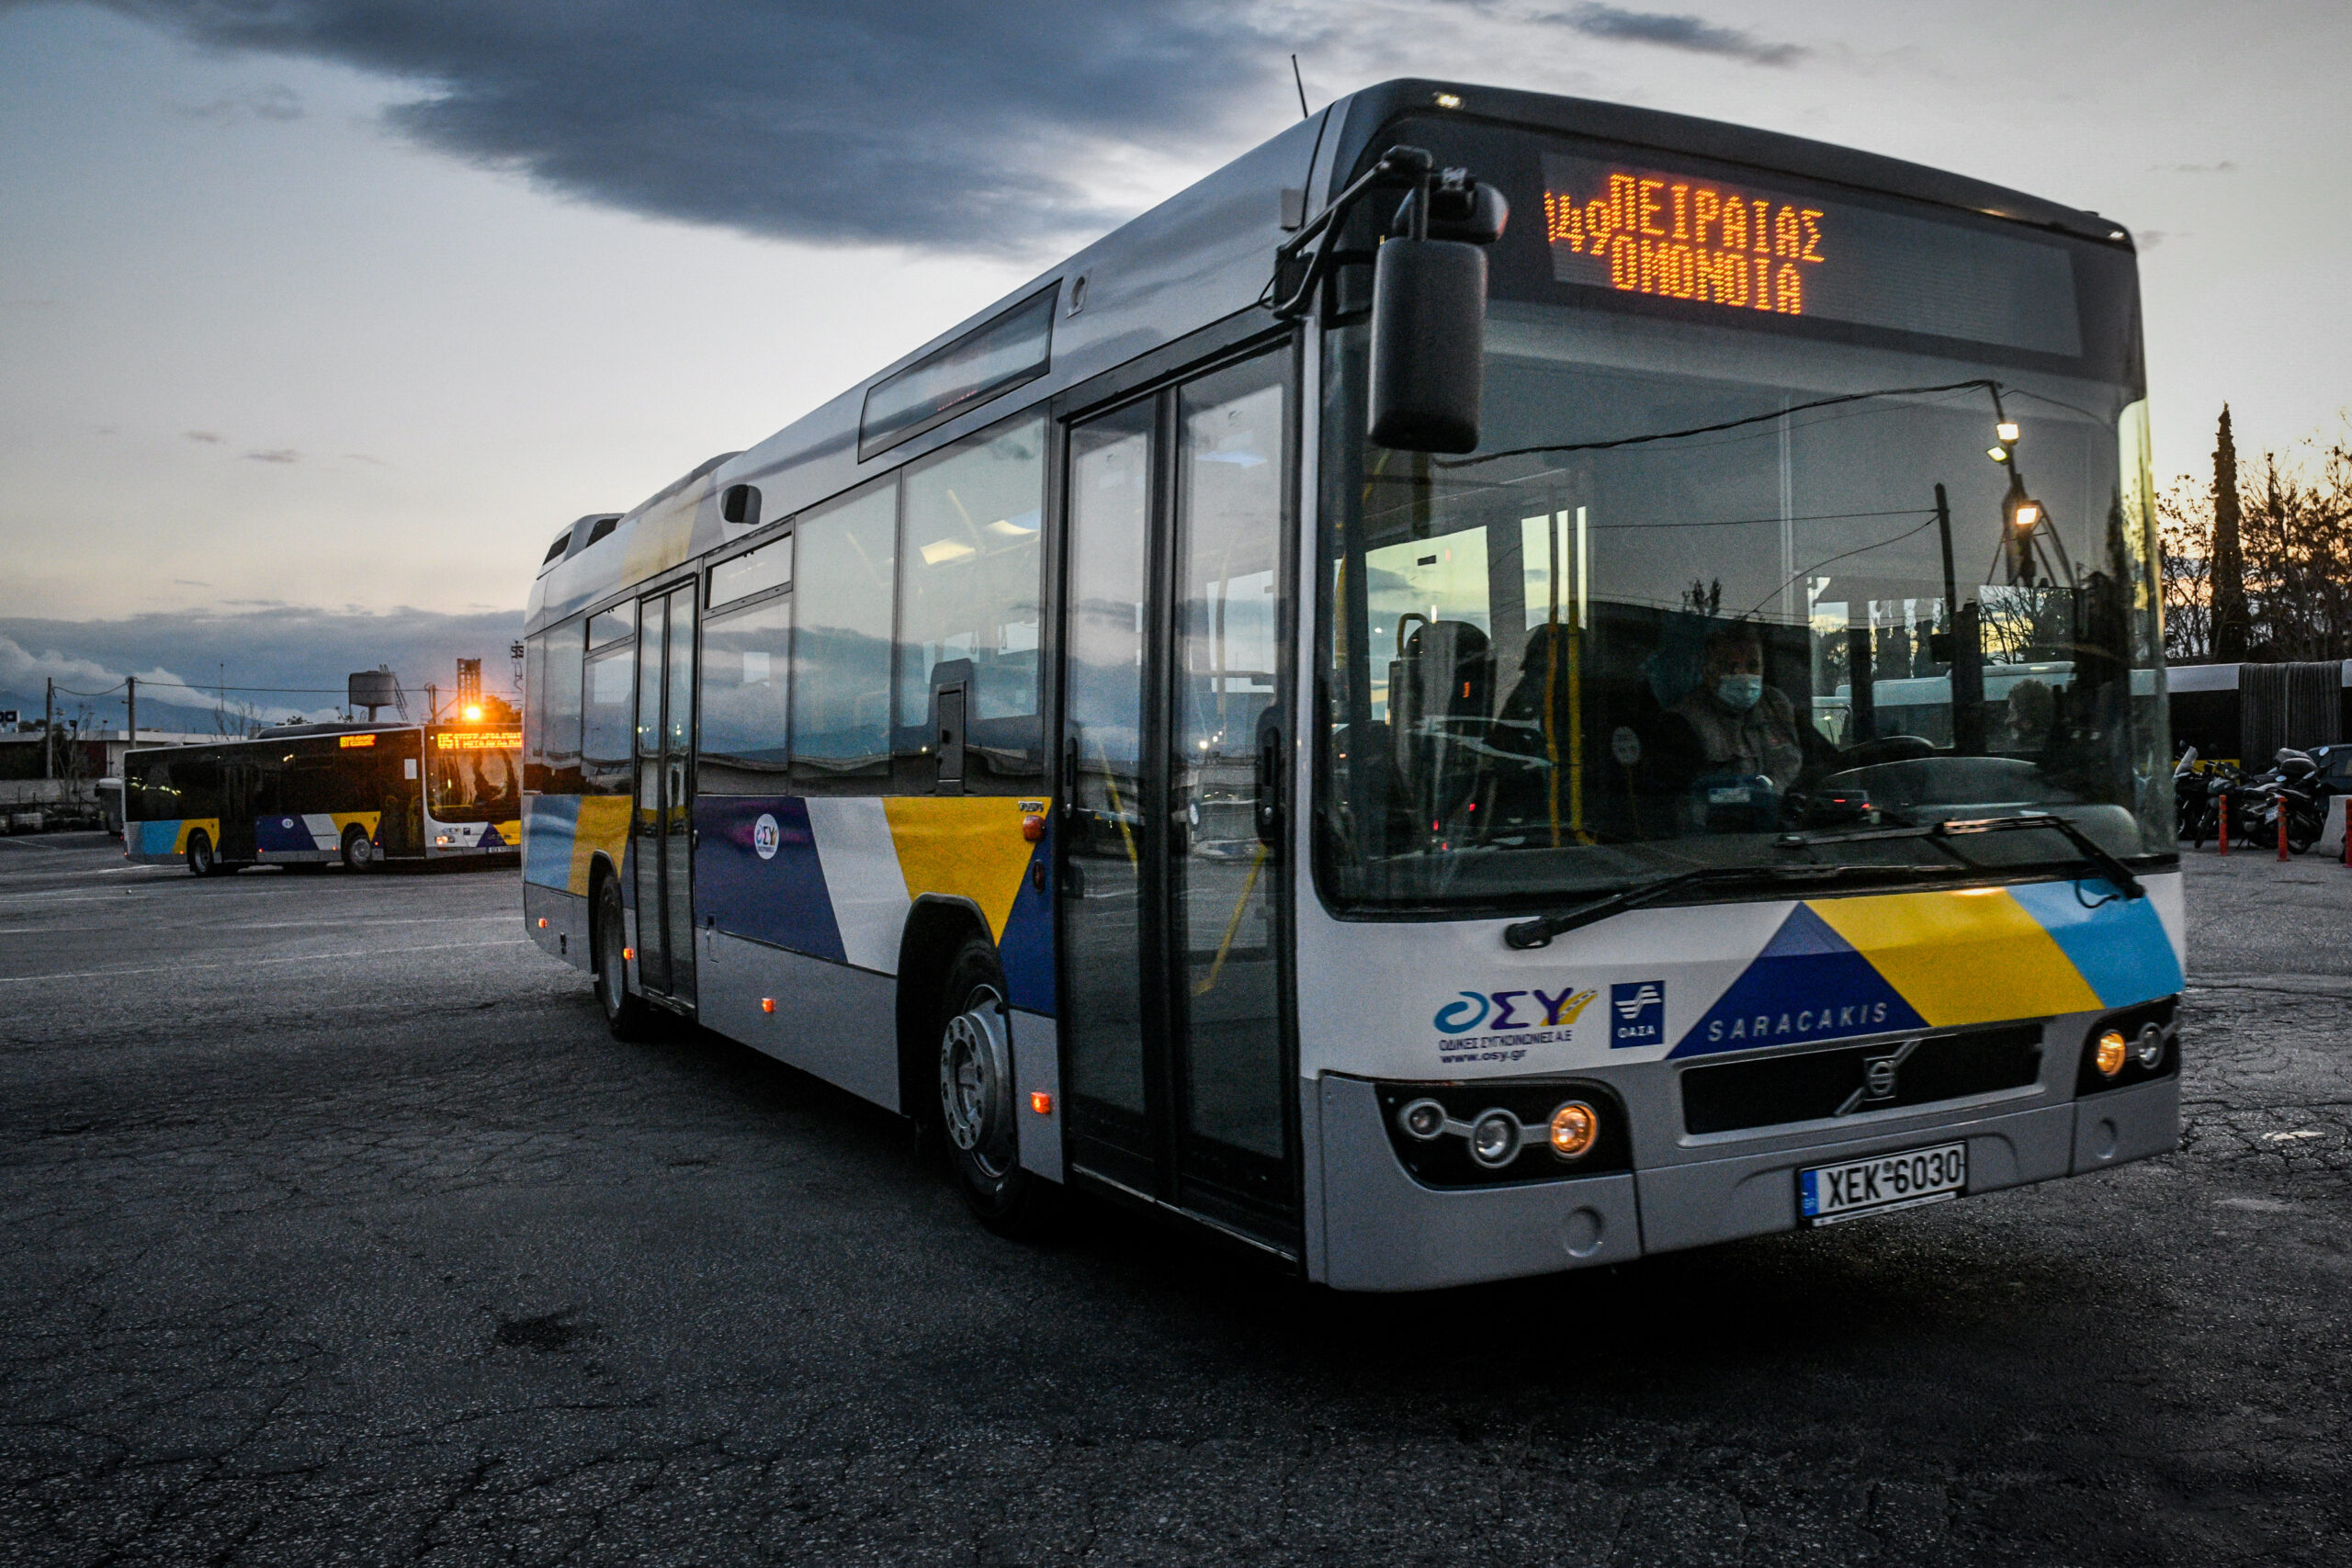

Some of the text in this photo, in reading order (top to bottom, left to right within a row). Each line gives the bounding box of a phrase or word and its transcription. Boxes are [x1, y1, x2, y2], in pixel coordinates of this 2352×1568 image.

[1611, 174, 1826, 264] ΠΕΙΡΑΙΑΣ
[1611, 234, 1802, 315] ΟΜΟΝΟΙΑ
[1617, 1024, 1656, 1038] ΟΑΣΑ
[1708, 1002, 1888, 1043] SARACAKIS
[1440, 1049, 1526, 1063] www.osy.gr
